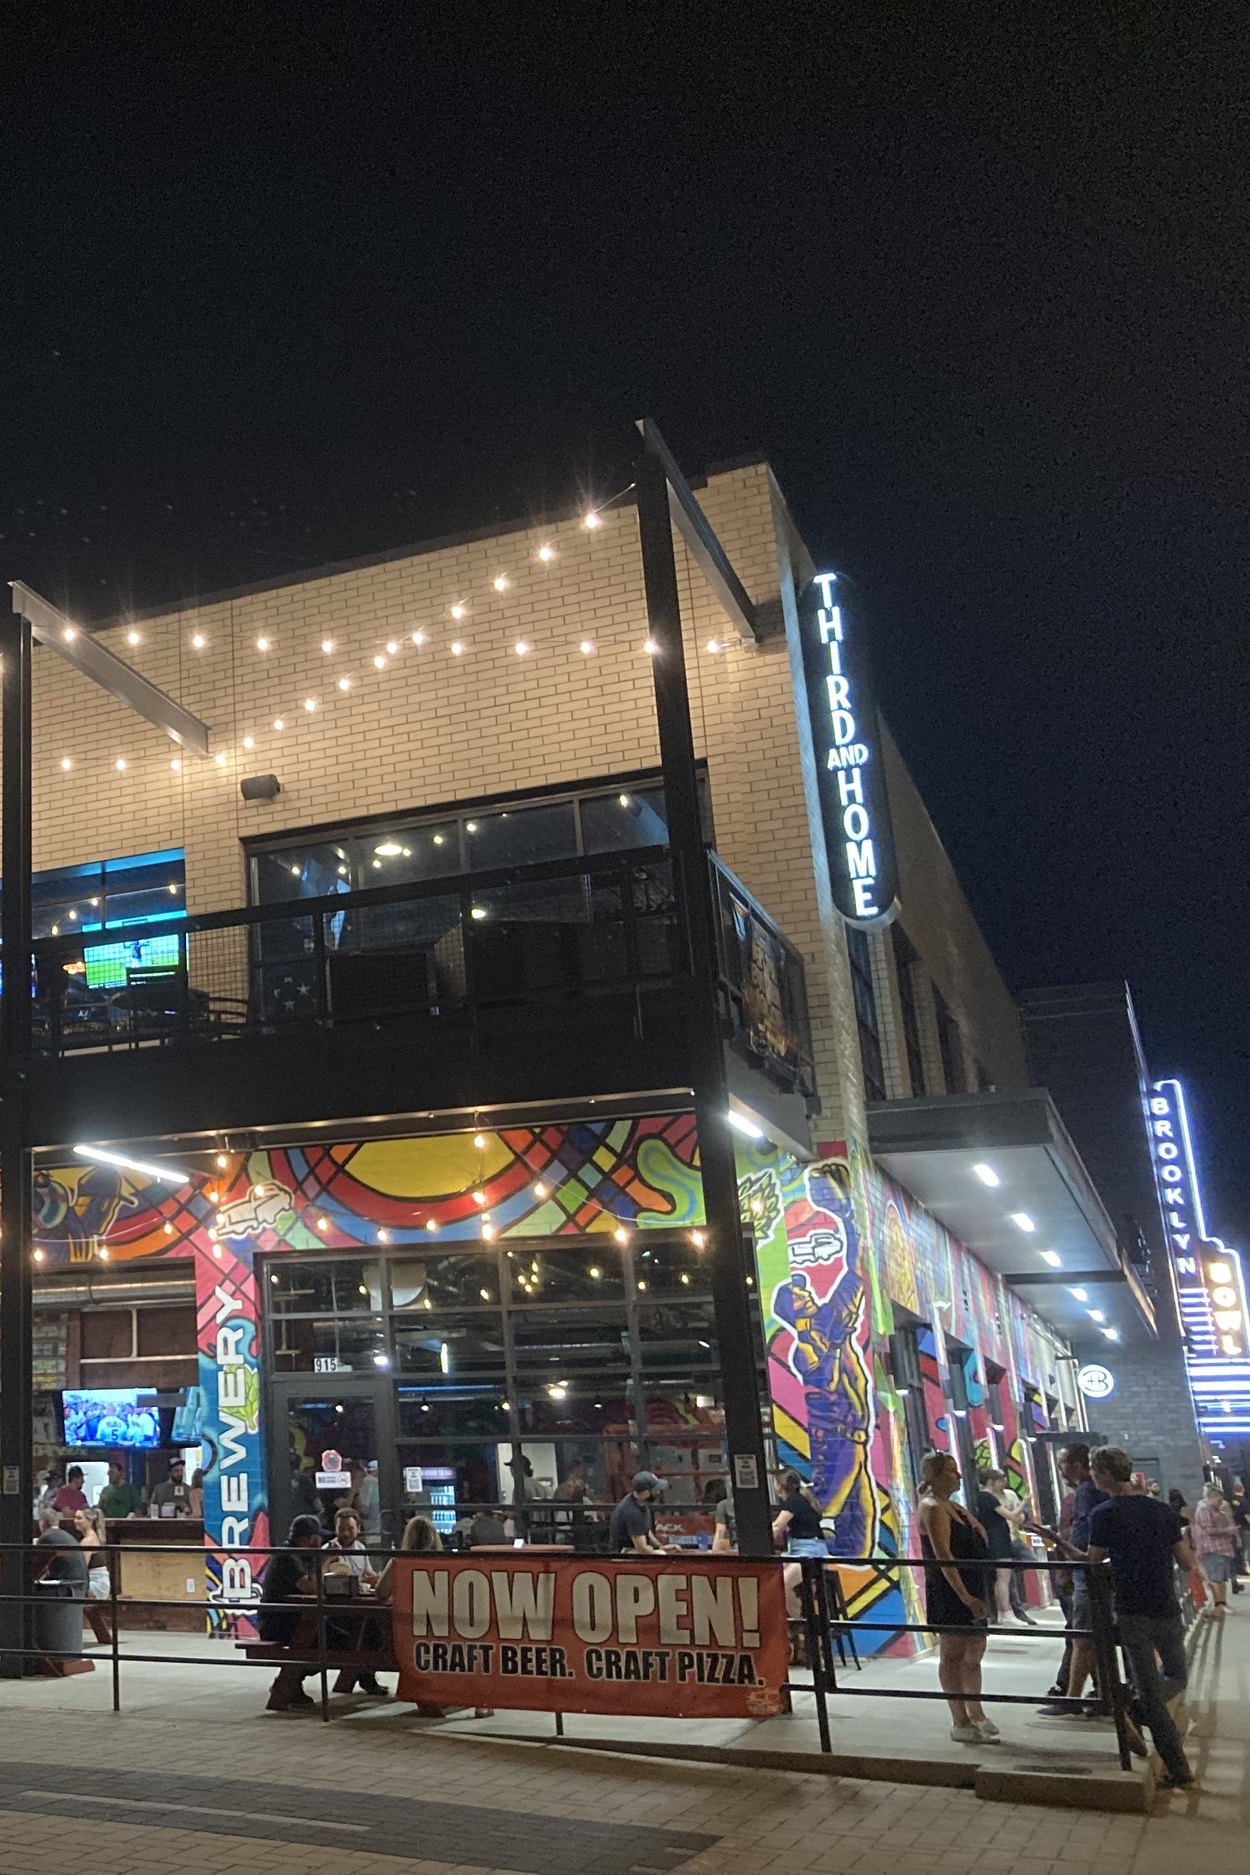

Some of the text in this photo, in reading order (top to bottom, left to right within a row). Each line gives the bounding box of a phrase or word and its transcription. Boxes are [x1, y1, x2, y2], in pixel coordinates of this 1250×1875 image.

[813, 572, 879, 917] THIRD AND HOME
[1150, 1097, 1242, 1355] BROOKLYN BOWL
[214, 1285, 252, 1598] BREWERY
[315, 1358, 337, 1372] 915
[412, 1569, 761, 1648] NOW OPEN!
[414, 1640, 766, 1688] CRAFT BEER. CRAFT PIZZA.
